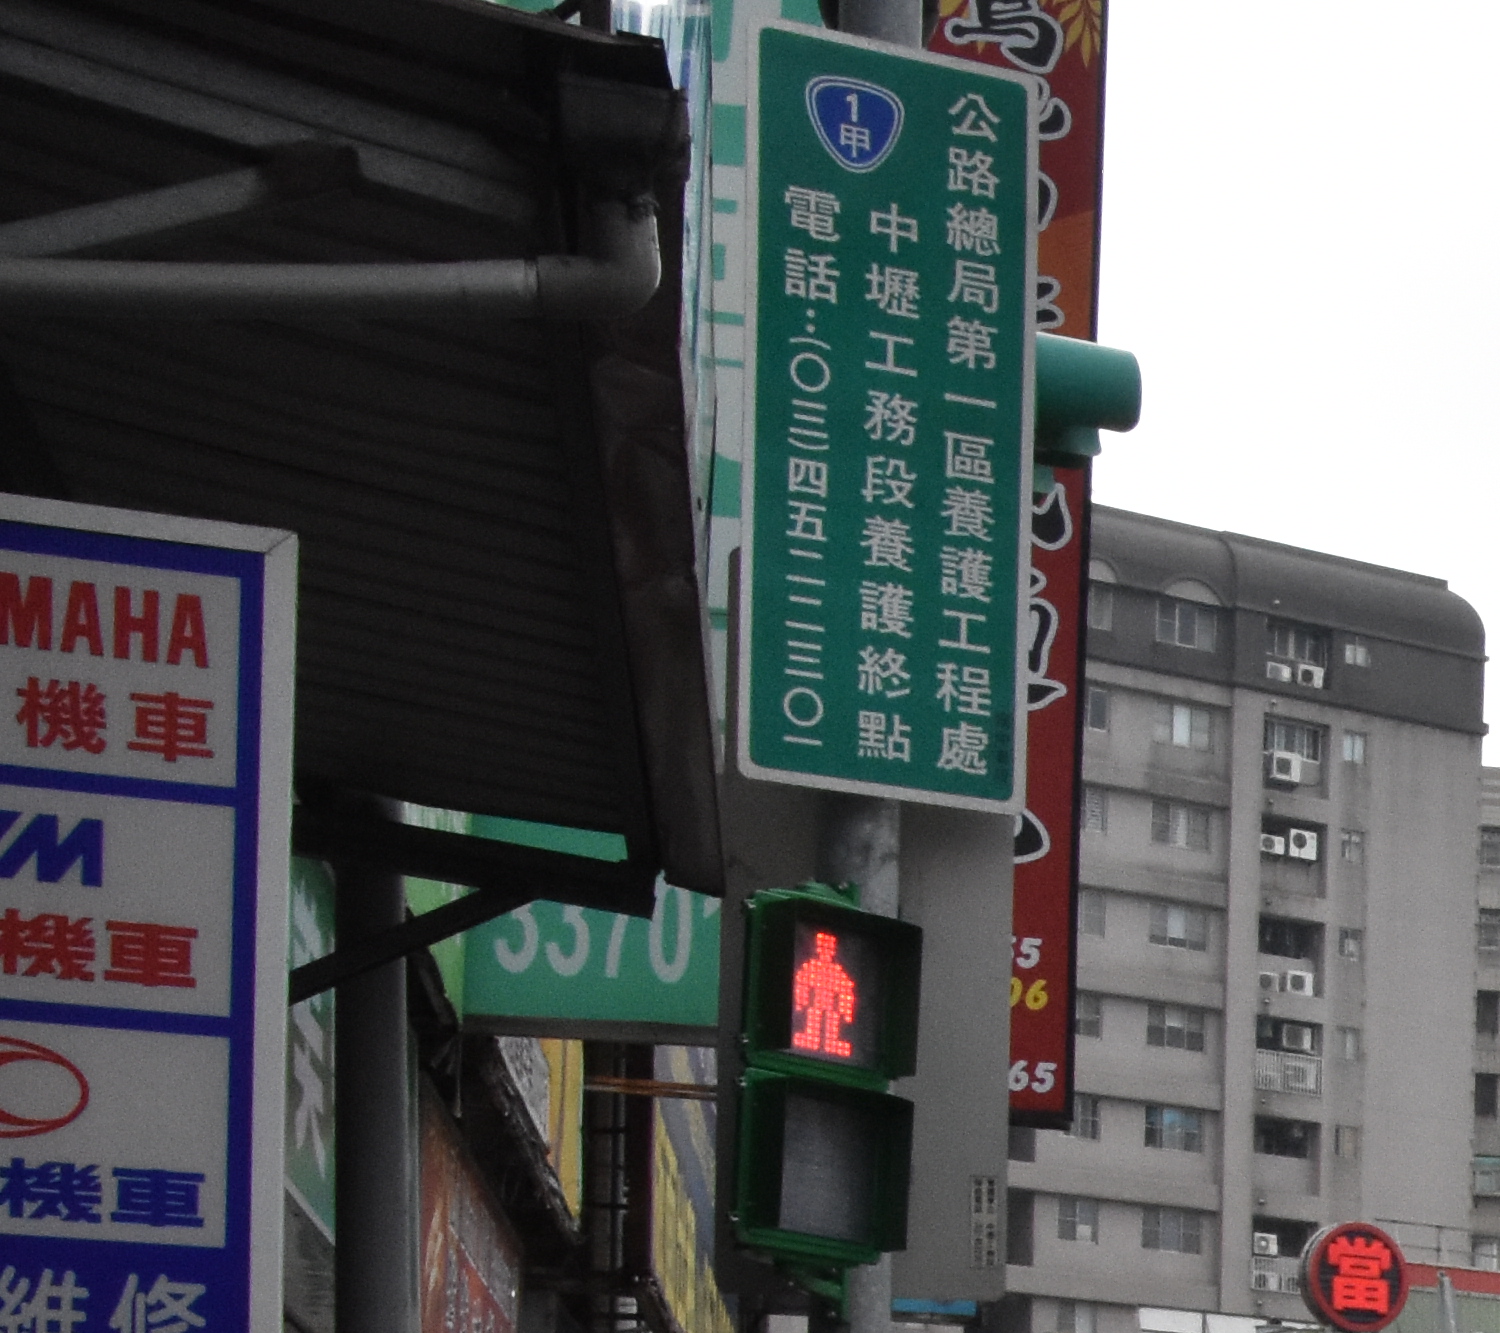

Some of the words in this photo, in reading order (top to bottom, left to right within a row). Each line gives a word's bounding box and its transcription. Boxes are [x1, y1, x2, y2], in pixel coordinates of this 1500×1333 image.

[840, 124, 872, 159] 甲
[845, 93, 861, 124] 1
[937, 92, 1001, 775] 公路總局第一區養護工程處
[857, 204, 920, 762] 中壢工務段養護終點
[16, 676, 215, 763] 機車
[0, 909, 198, 988] 機車
[1, 1157, 206, 1228] 機車
[1327, 1233, 1394, 1315] 當
